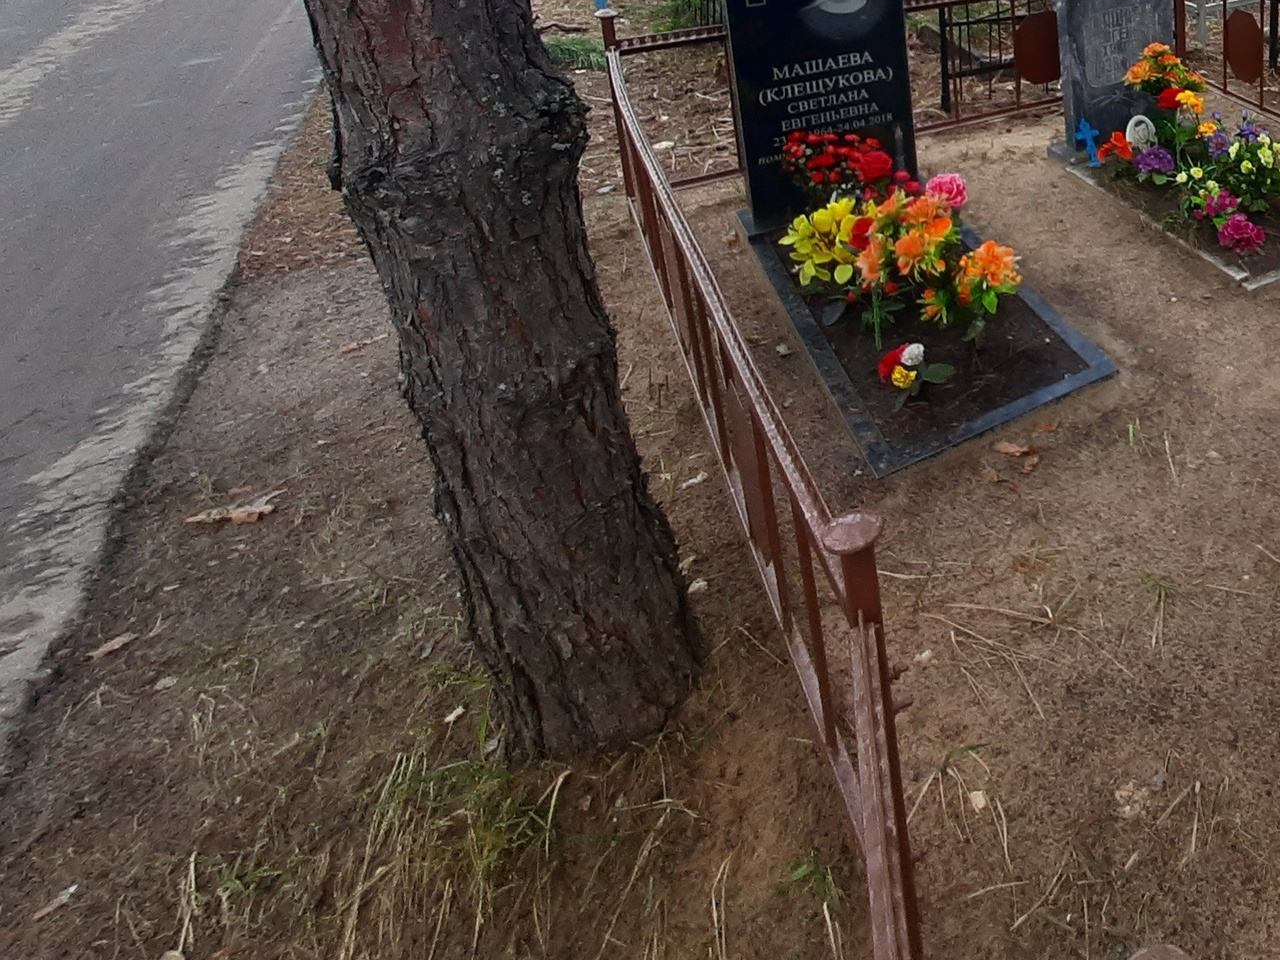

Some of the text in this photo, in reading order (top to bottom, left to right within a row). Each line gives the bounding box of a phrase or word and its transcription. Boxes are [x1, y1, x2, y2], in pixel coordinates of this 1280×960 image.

[772, 51, 873, 81] МАШАЕВА
[758, 67, 893, 107] (КЛЕЩУКОВА)
[787, 89, 869, 114] СВЕТЛАНА
[781, 102, 879, 132] ЕВГЕНЬЕВНА
